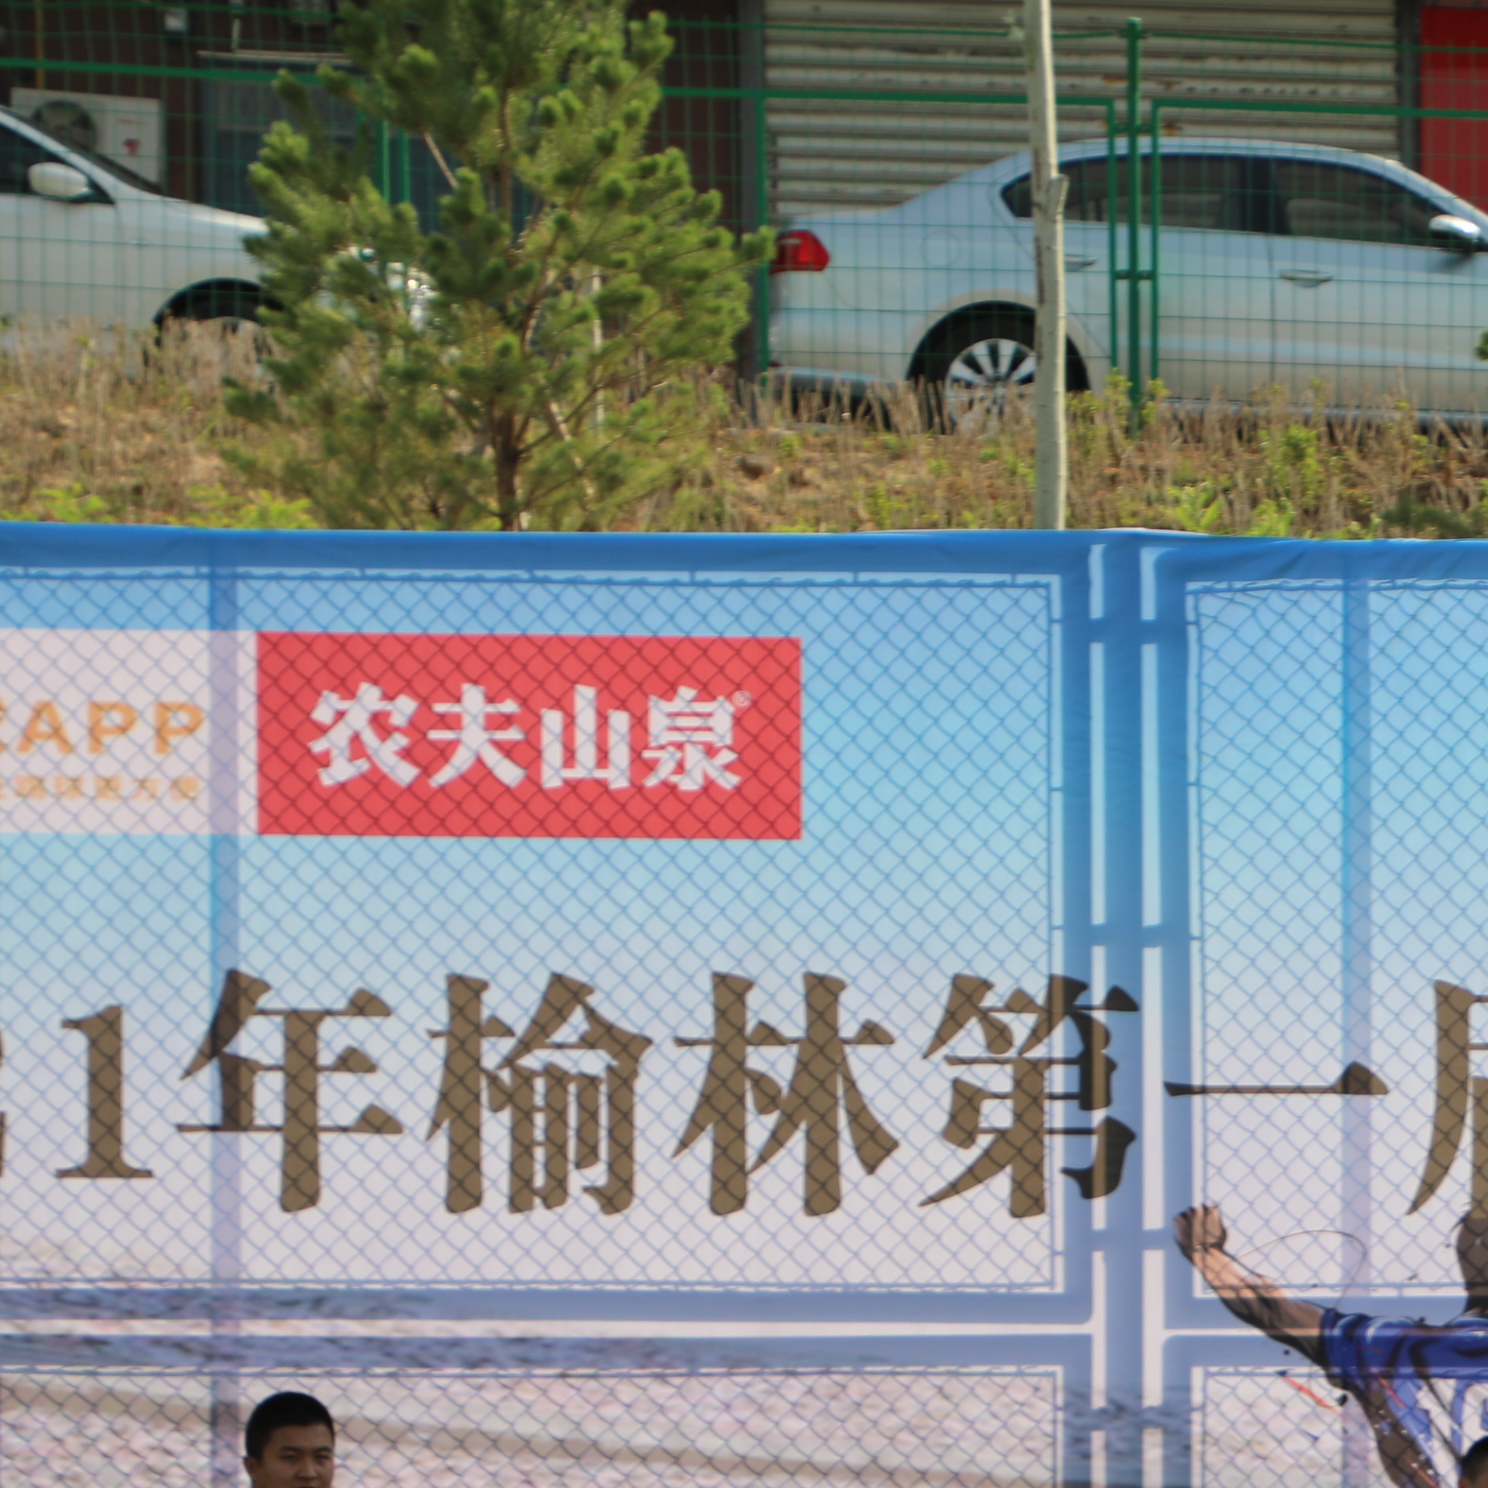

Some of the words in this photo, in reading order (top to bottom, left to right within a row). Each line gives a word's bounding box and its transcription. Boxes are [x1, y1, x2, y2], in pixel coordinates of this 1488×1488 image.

[0, 699, 206, 755] APP
[307, 682, 743, 791] 农夫山泉
